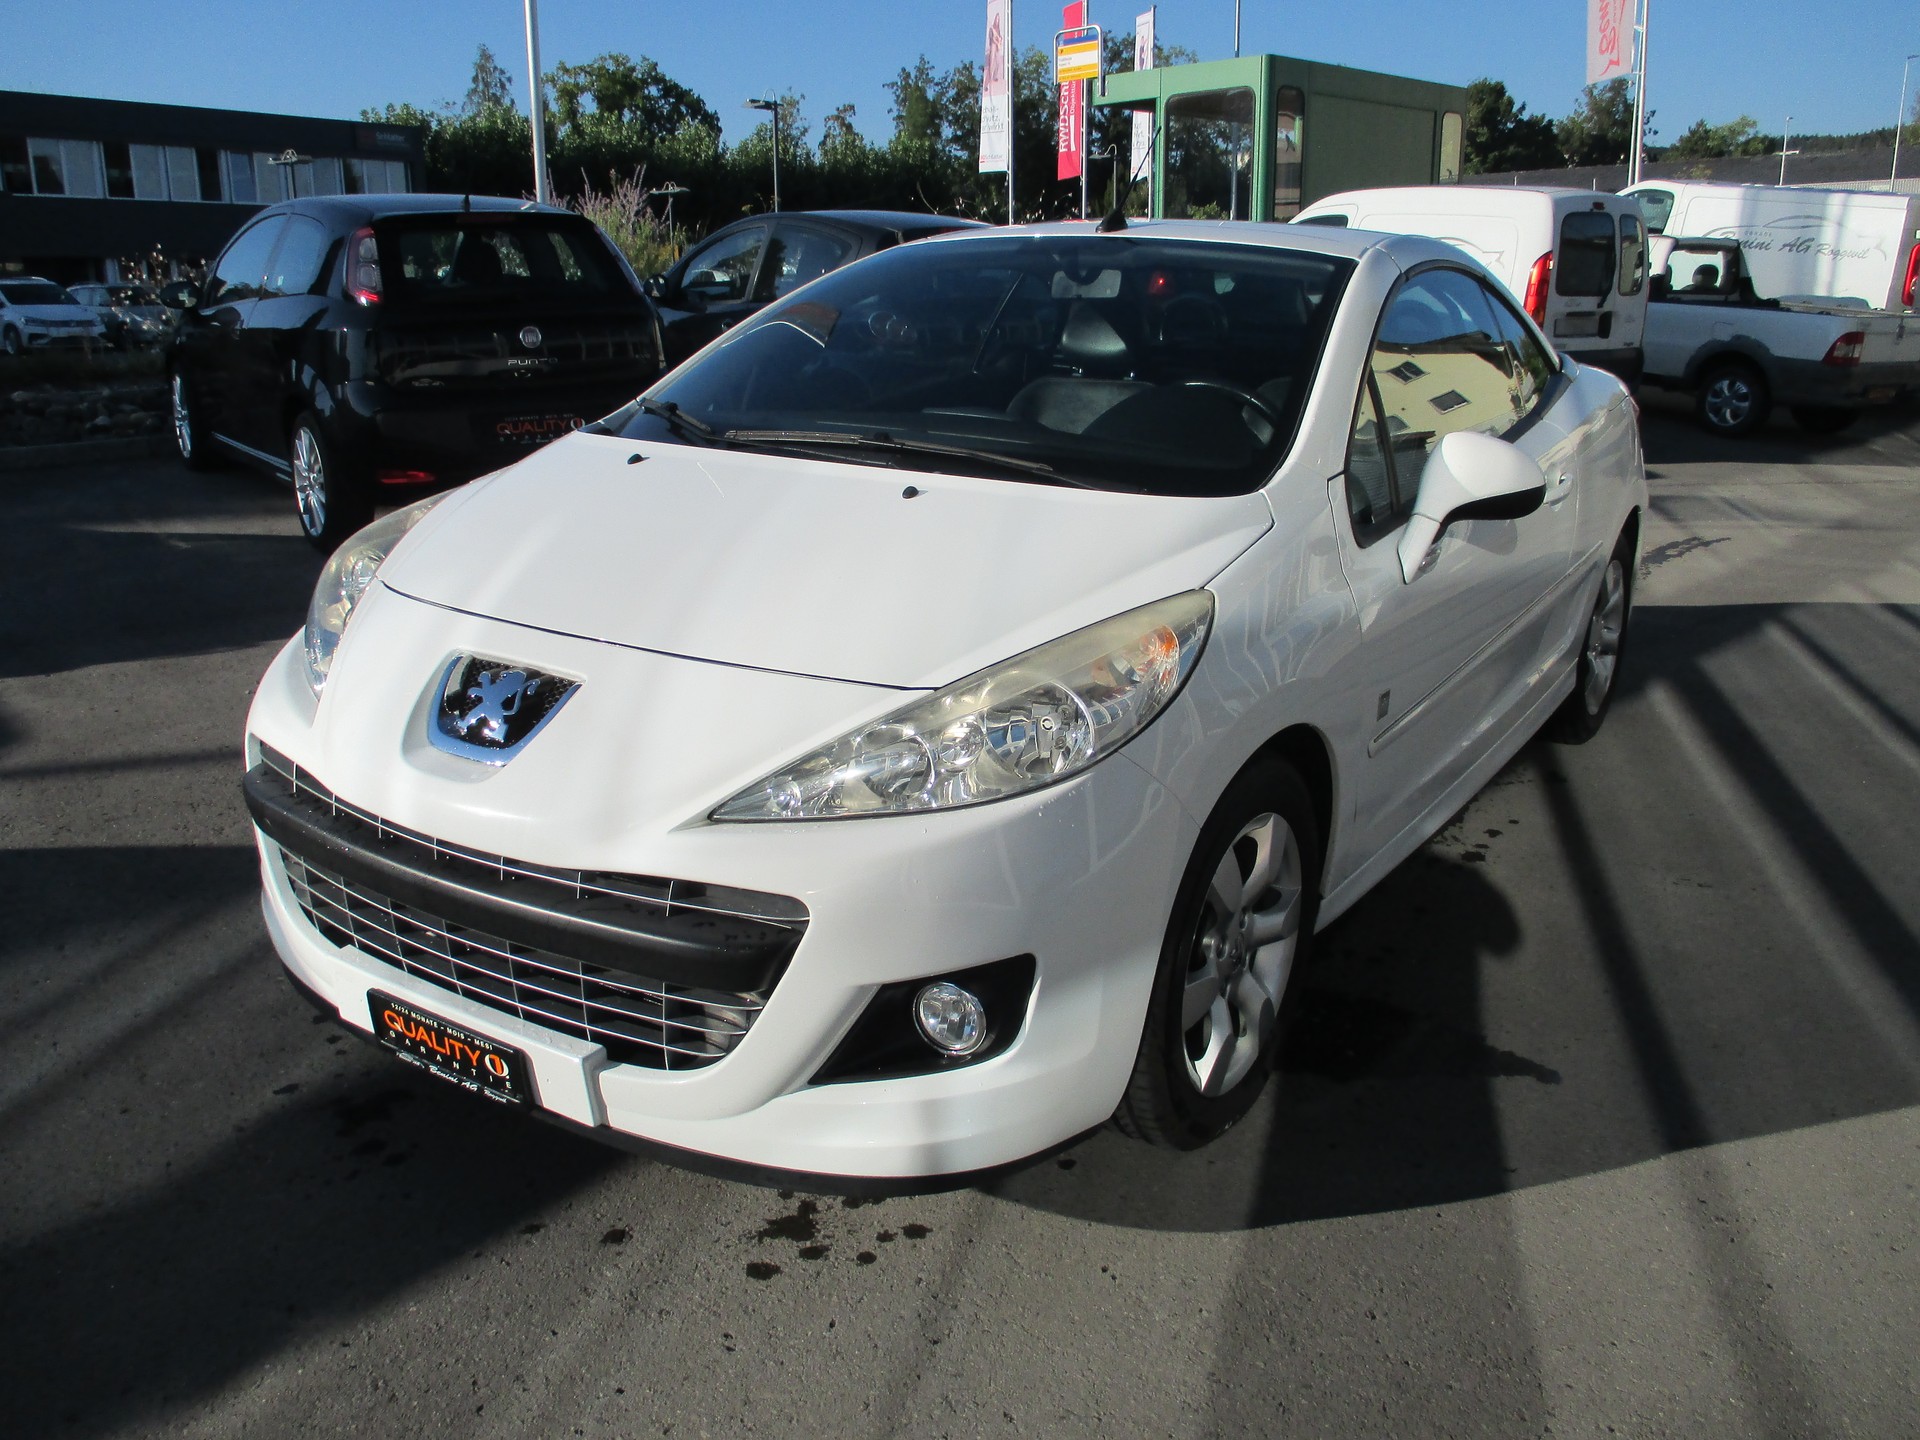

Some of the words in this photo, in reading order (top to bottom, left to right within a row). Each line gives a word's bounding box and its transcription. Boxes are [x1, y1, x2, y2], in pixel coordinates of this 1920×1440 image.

[1778, 236, 1815, 254] AG
[1815, 242, 1871, 261] Roggwil
[496, 419, 567, 435] QUALITY
[383, 1010, 481, 1066] QUALITY
[411, 1011, 438, 1028] MONATE
[446, 1027, 465, 1039] MOIS
[474, 1038, 493, 1051] MESI
[389, 1030, 512, 1089] GARANTIE
[461, 1081, 478, 1092] AG
